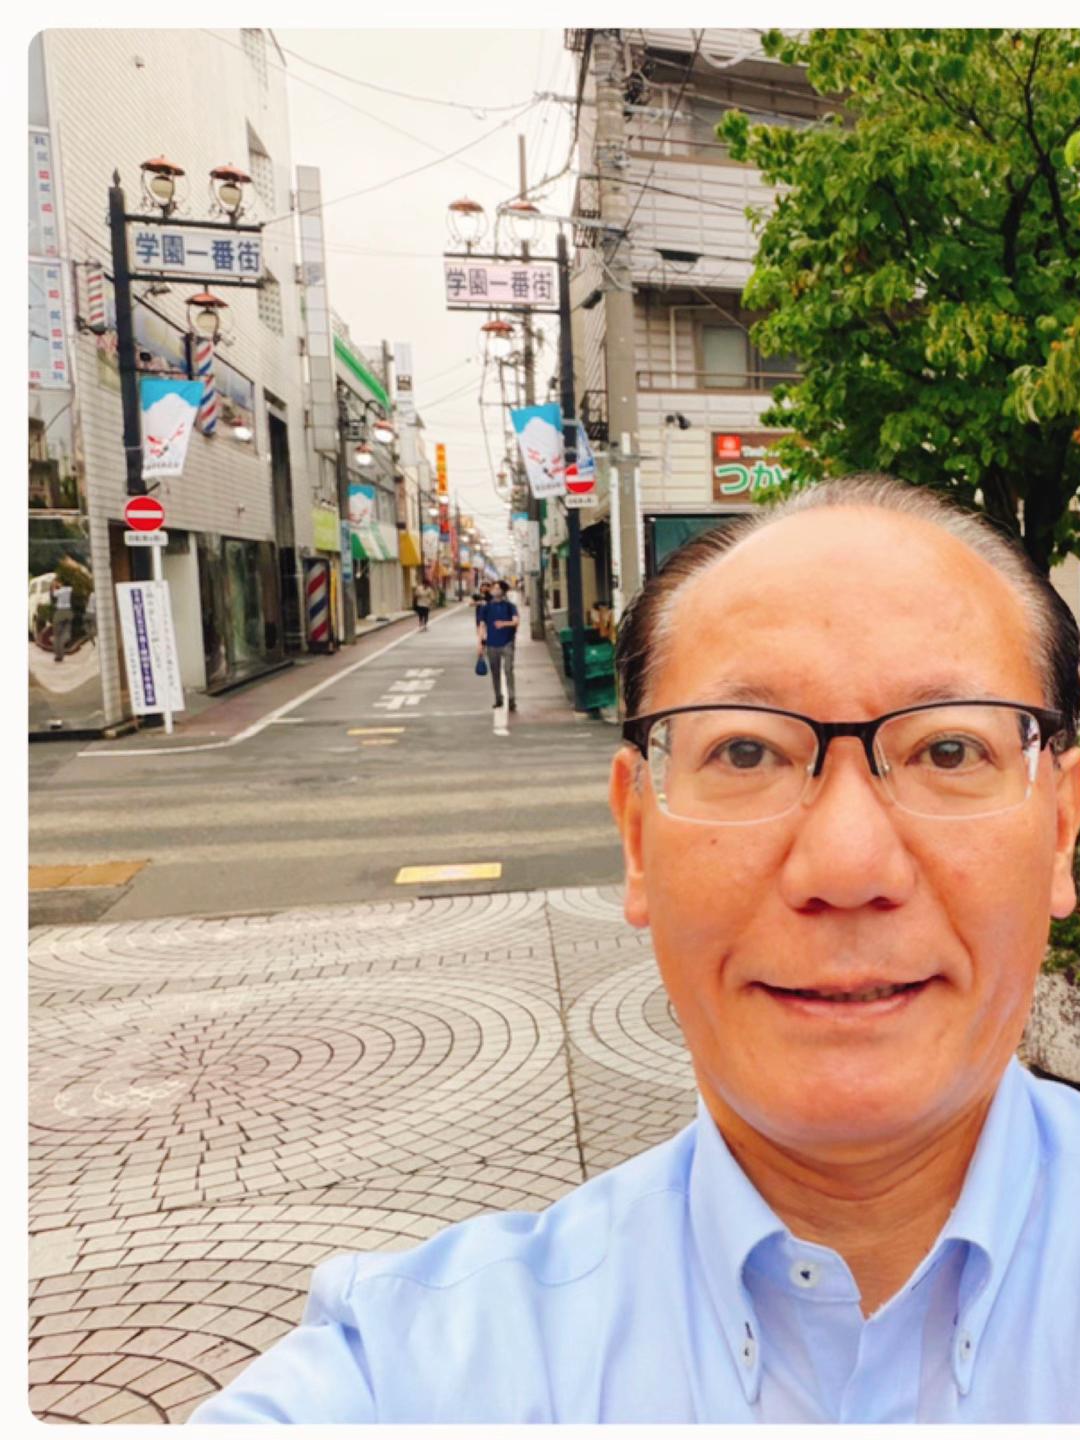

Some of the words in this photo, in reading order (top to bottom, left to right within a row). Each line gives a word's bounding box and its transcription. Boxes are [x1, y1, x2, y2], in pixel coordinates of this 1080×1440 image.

[135, 232, 261, 272] 学園一番街
[446, 267, 553, 300] 学園一番街
